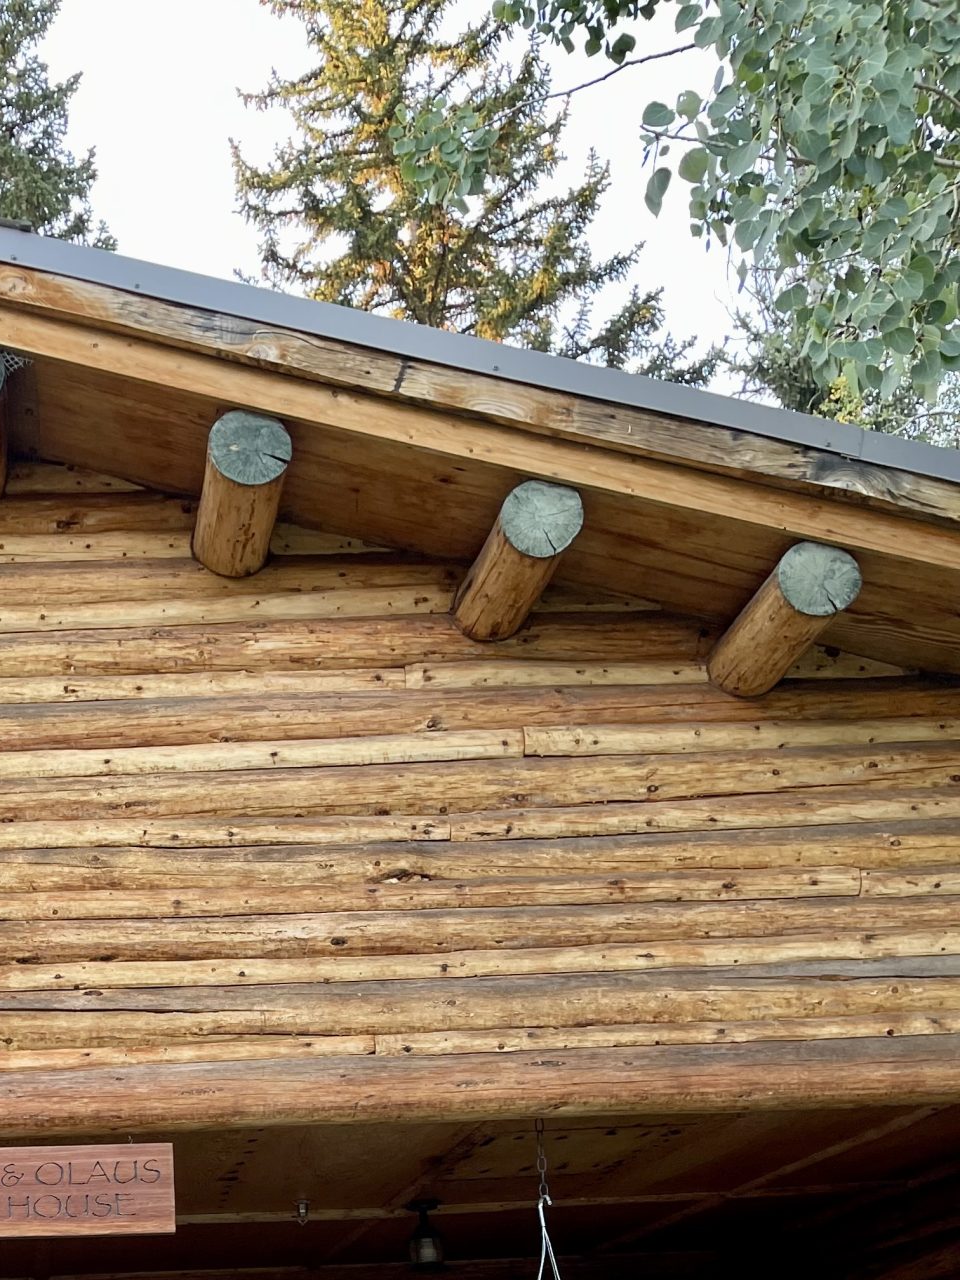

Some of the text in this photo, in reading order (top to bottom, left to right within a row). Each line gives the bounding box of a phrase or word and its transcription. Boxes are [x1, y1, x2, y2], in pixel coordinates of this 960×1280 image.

[0, 1163, 25, 1188] &
[34, 1158, 161, 1187] OLAUS
[7, 1194, 137, 1219] HOUSE
